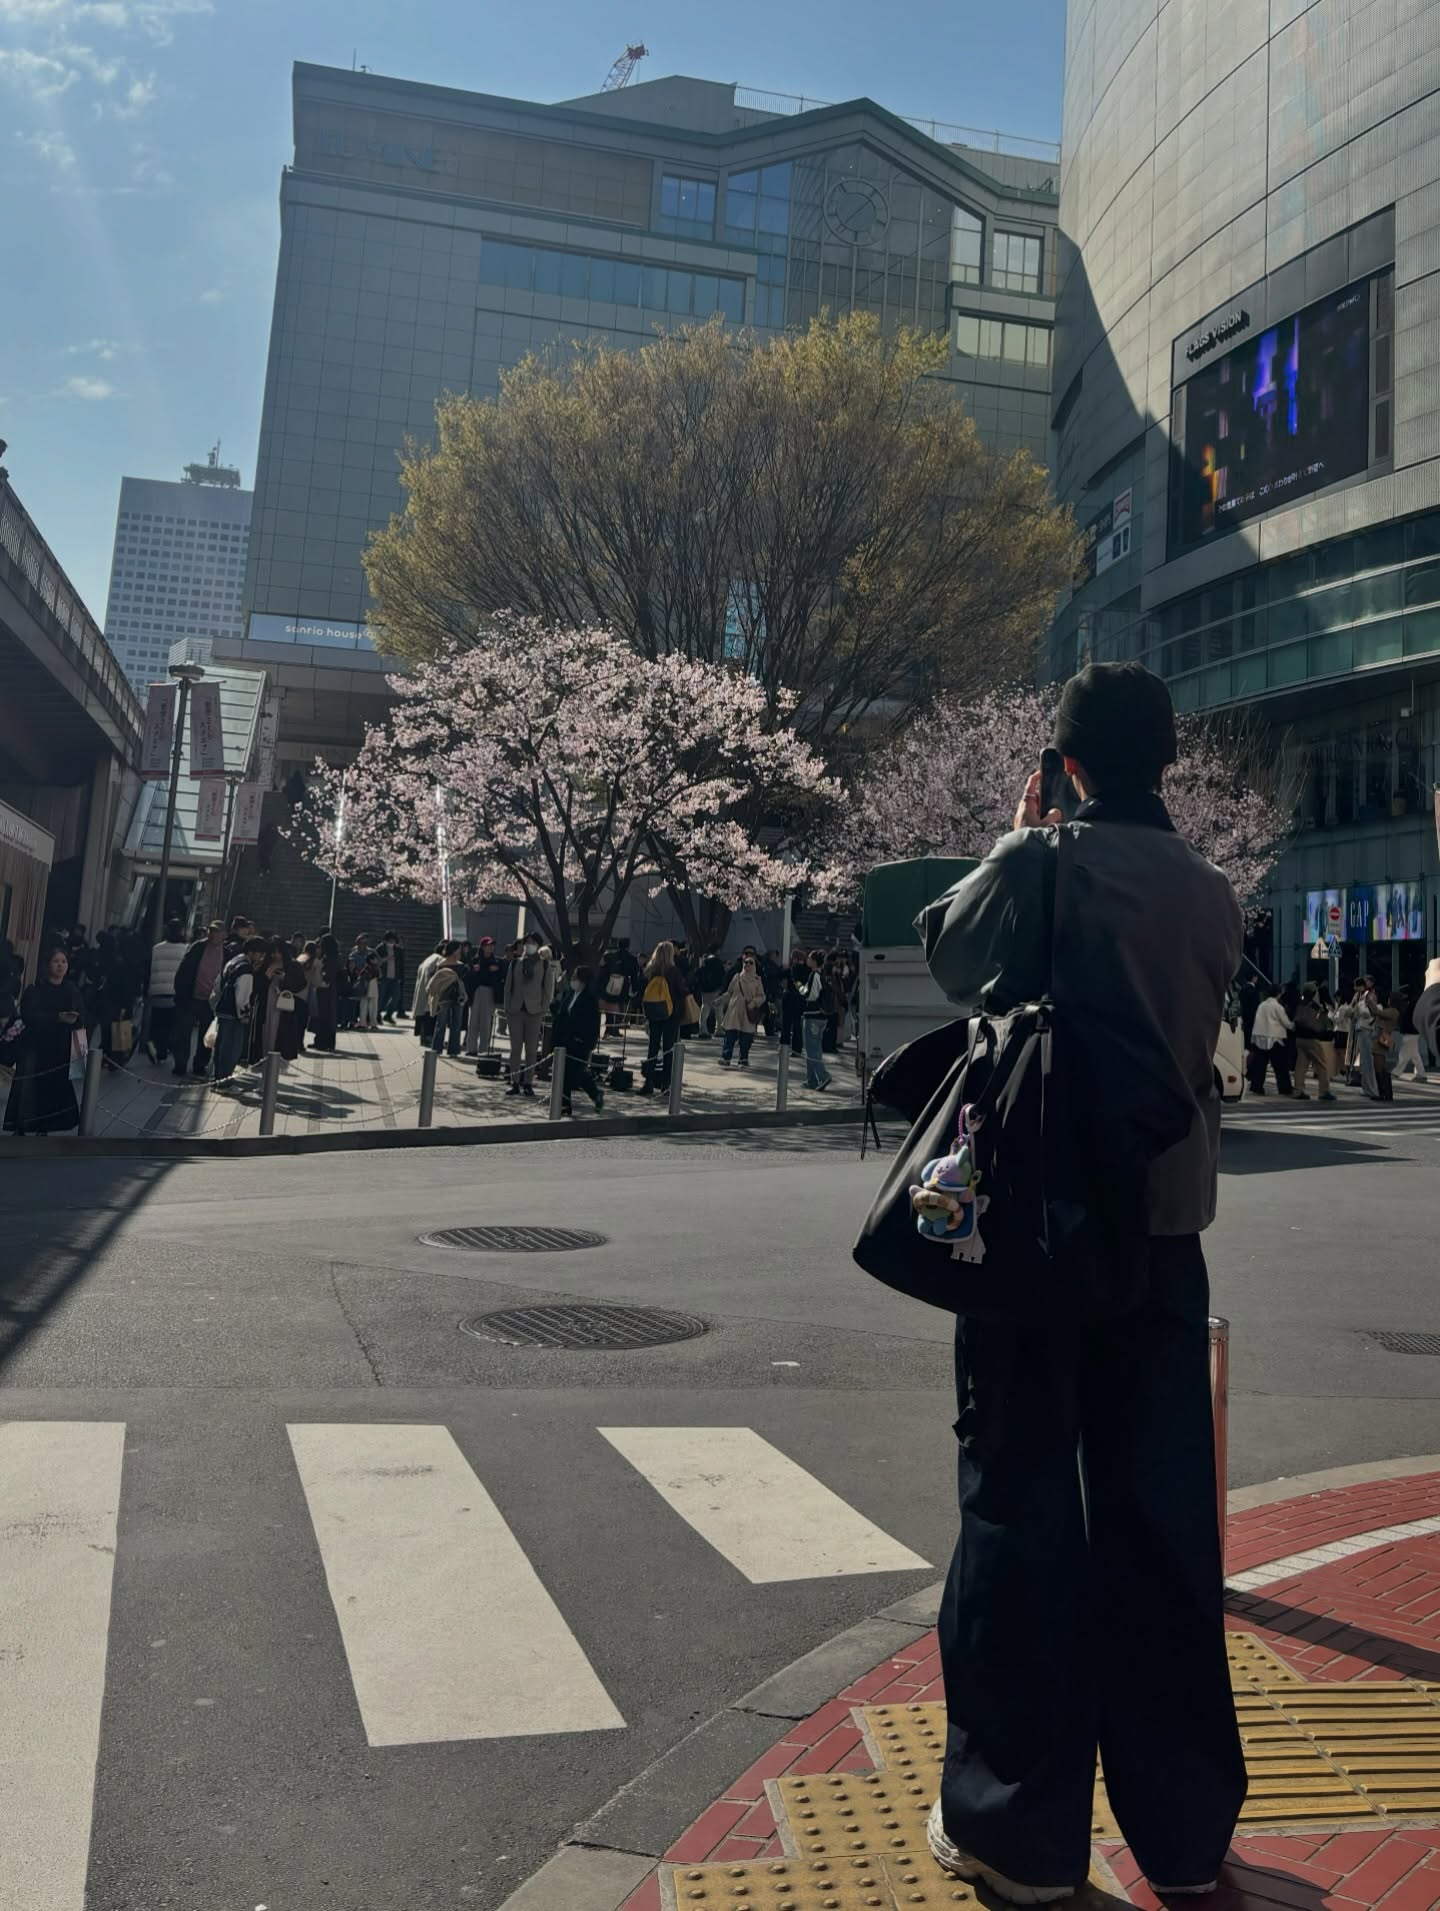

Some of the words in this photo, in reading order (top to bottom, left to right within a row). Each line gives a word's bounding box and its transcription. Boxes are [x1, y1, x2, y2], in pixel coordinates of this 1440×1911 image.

[1212, 311, 1242, 339] VISION
[285, 625, 324, 636] sanrio
[326, 627, 362, 639] house
[1350, 900, 1369, 928] GAP
